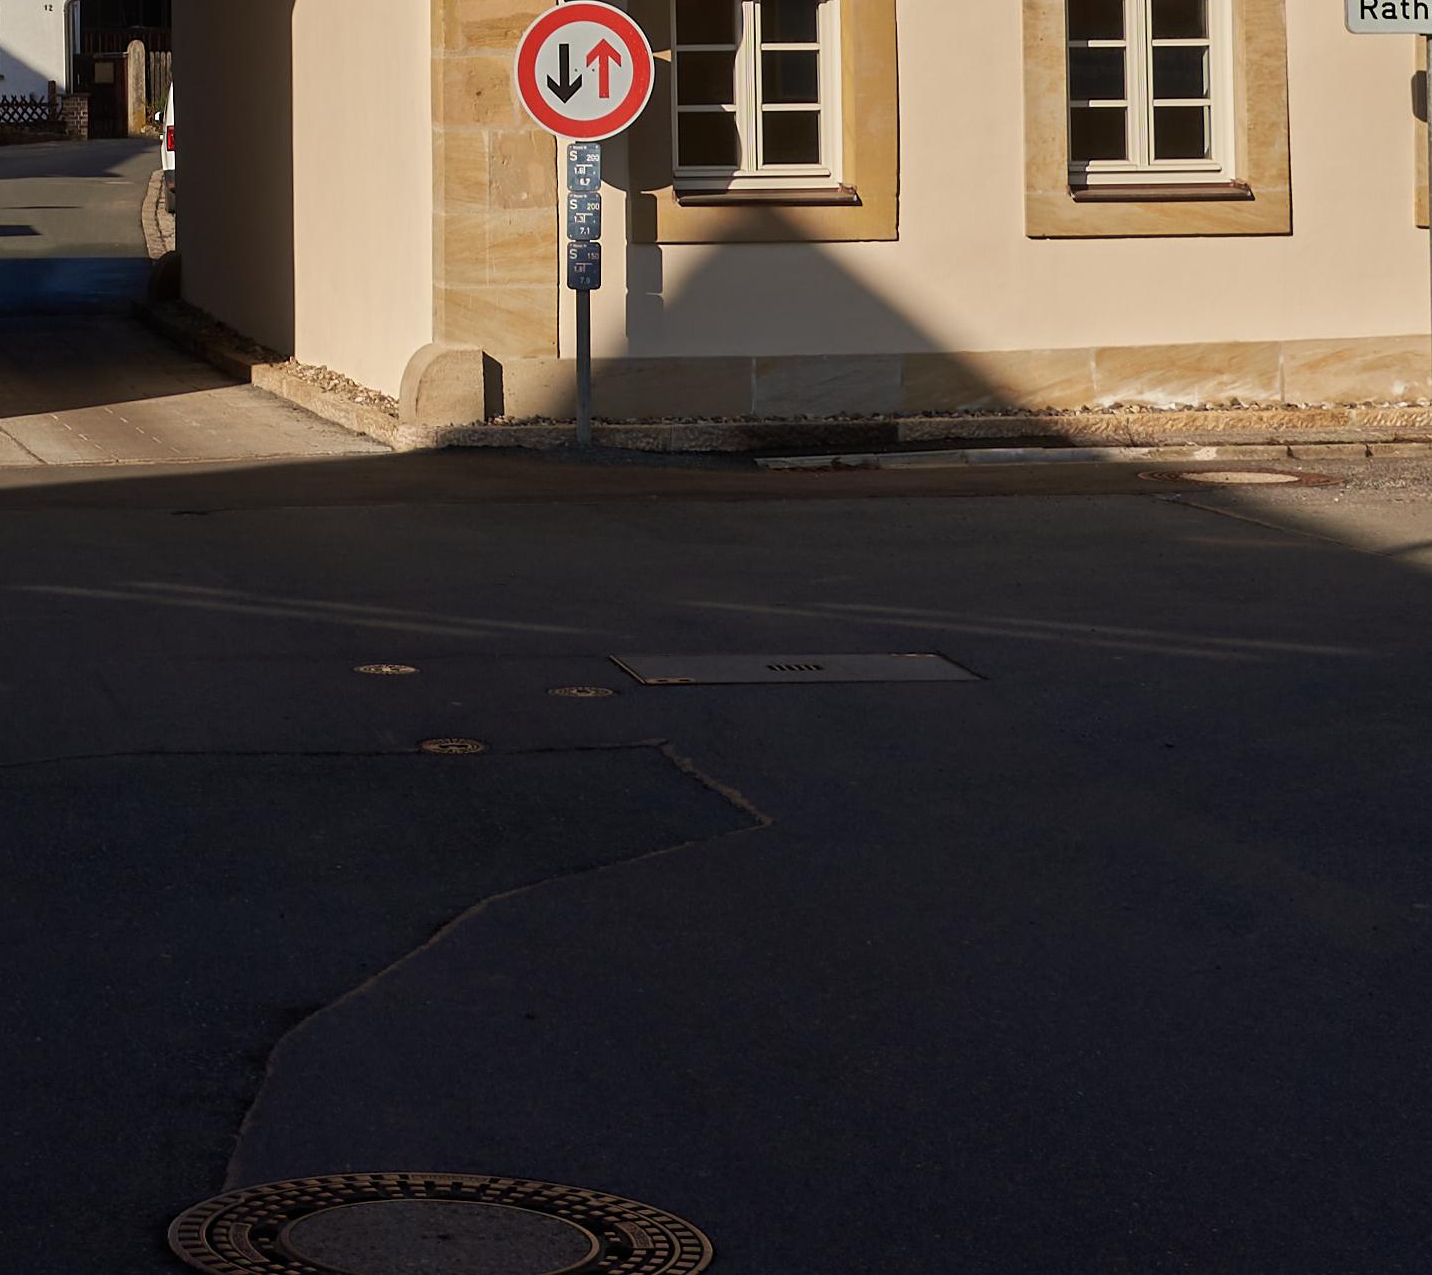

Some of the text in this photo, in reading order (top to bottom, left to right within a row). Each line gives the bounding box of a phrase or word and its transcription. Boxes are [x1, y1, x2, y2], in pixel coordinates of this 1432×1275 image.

[44, 4, 53, 12] 12
[569, 150, 578, 161] S
[569, 199, 600, 211] S 200
[579, 226, 590, 235] 7.1
[569, 248, 578, 260] S
